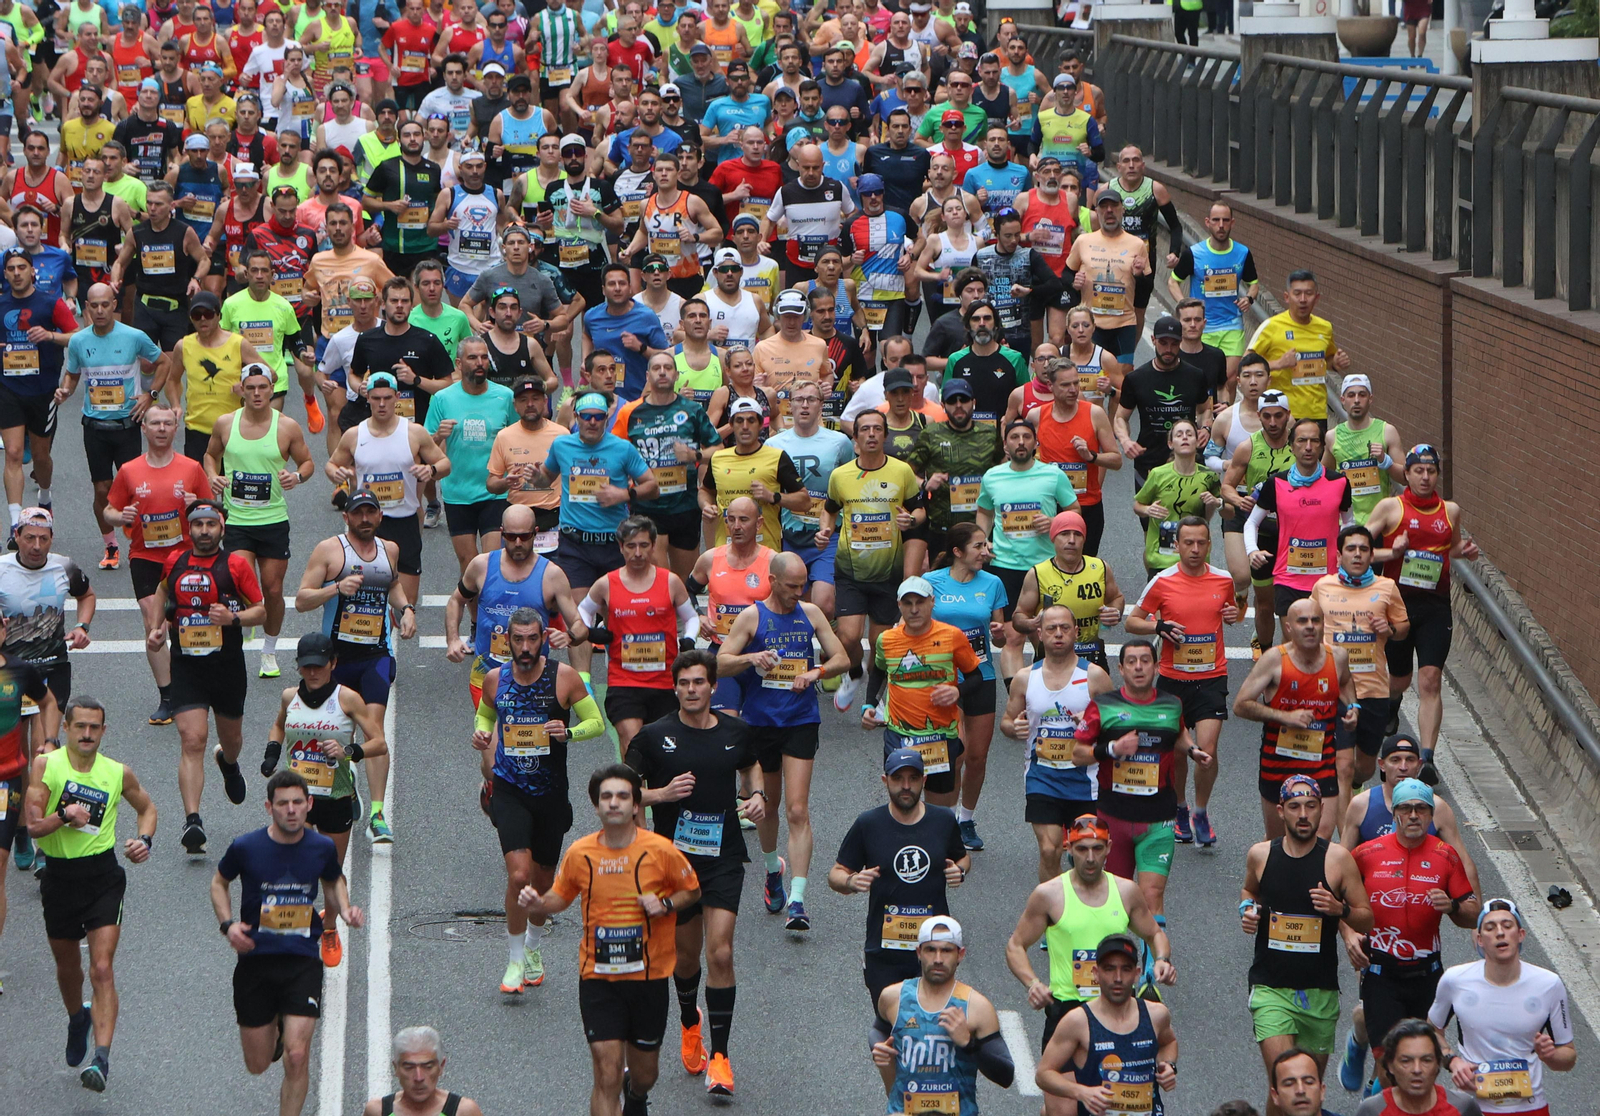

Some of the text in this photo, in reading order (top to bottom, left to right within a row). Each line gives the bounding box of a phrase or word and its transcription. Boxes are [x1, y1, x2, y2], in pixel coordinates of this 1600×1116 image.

[654, 212, 661, 229] S
[152, 513, 174, 521] ZURICH
[1419, 552, 1440, 561] ZURICH
[1410, 572, 1433, 580] FERNANDO
[1077, 583, 1102, 600] 428
[963, 629, 980, 637] RICH
[766, 636, 809, 646] FUENTES
[766, 673, 778, 682] JOSÉ
[286, 718, 340, 731] maratón
[916, 734, 942, 744] ZURICH
[1129, 754, 1156, 762] ZURICH
[304, 768, 320, 776] 3859
[79, 787, 104, 800] ZURICH
[694, 814, 720, 822] ZURICH
[690, 827, 710, 836] 12089
[692, 838, 719, 847] FERREIRA
[902, 906, 928, 914] ZURICH
[900, 922, 917, 930] 6186
[1286, 922, 1304, 932] 5087
[609, 929, 638, 937] ZURICH
[899, 932, 918, 940] RUBÉN
[1096, 1042, 1115, 1051] 226ERS
[918, 1066, 941, 1074] SPORTS
[1494, 1063, 1524, 1071] ZURICH
[1124, 1074, 1150, 1082] ZURICH
[922, 1083, 953, 1091] ZURICH
[1495, 1078, 1514, 1088] 5509
[1122, 1090, 1140, 1098] 4557
[922, 1100, 941, 1109] 5233
